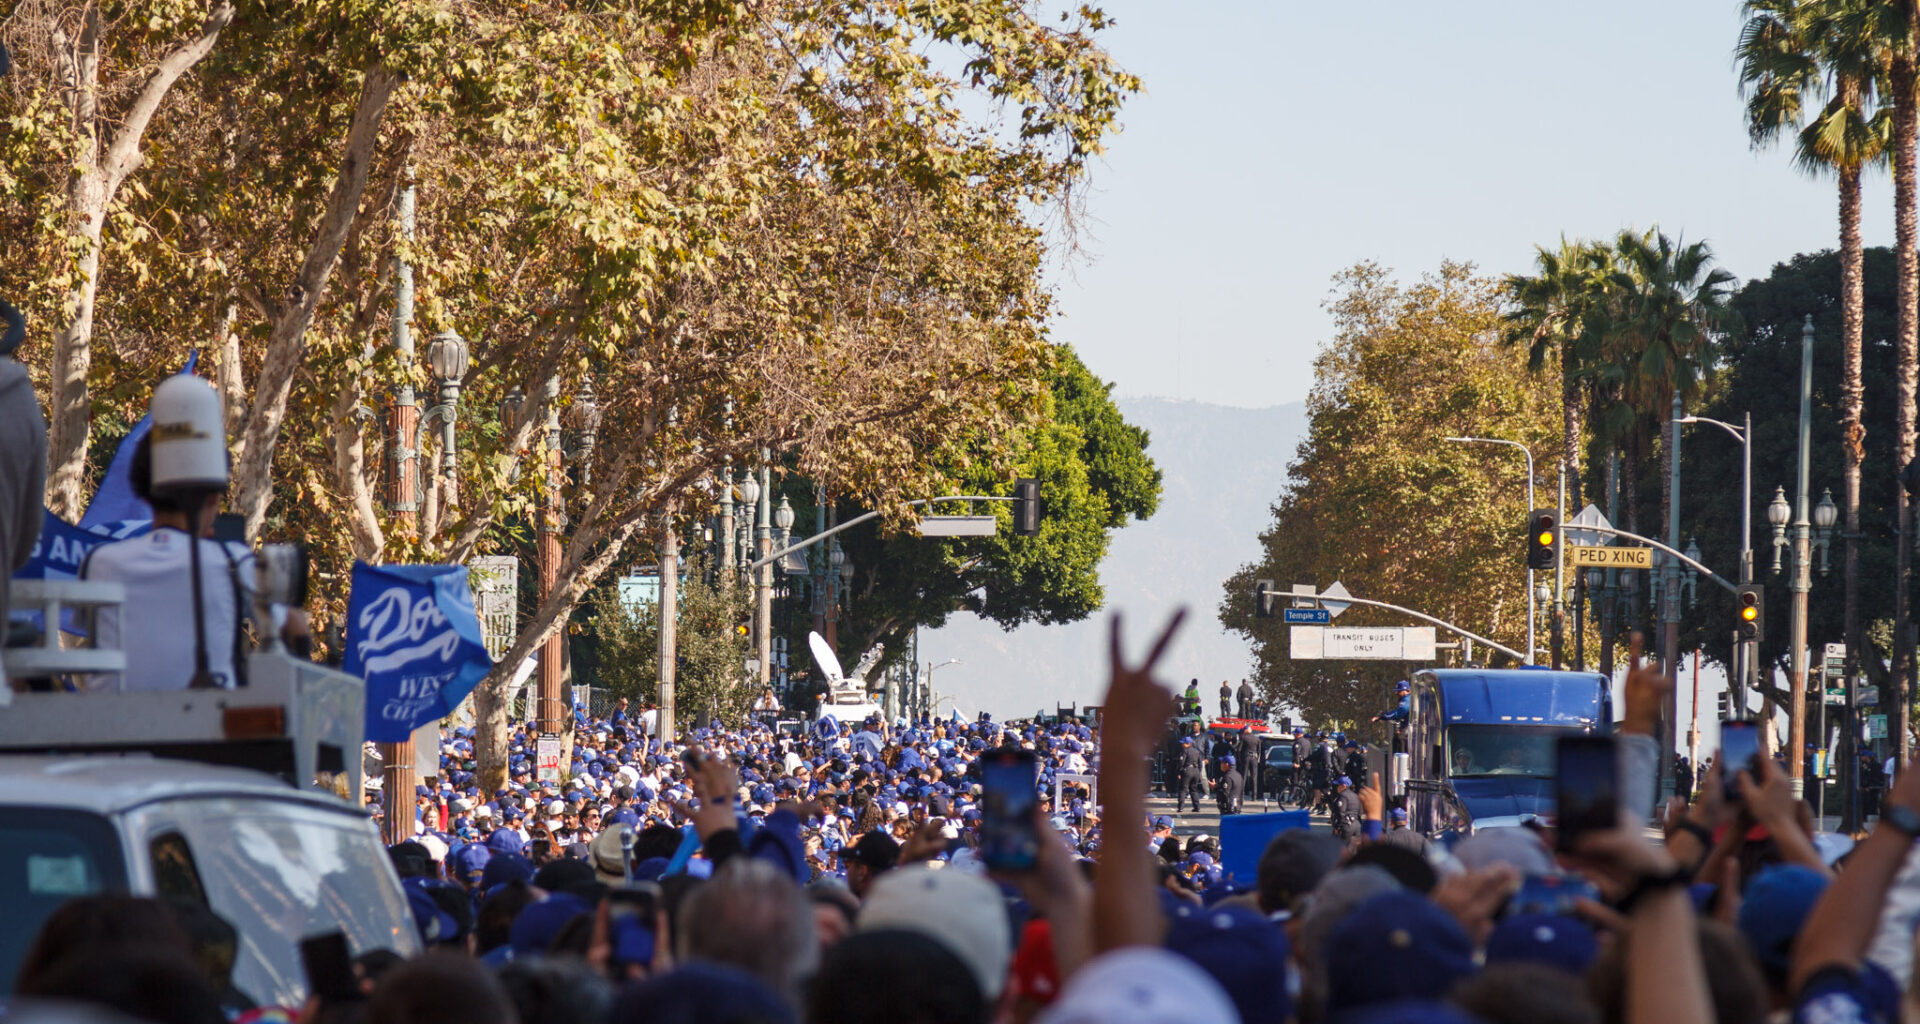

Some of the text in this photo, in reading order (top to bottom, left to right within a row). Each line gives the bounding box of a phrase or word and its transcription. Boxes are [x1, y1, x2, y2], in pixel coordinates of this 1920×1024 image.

[1580, 549, 1645, 564] PED XING
[1288, 611, 1327, 621] Temple St
[1369, 634, 1394, 642] BUSES
